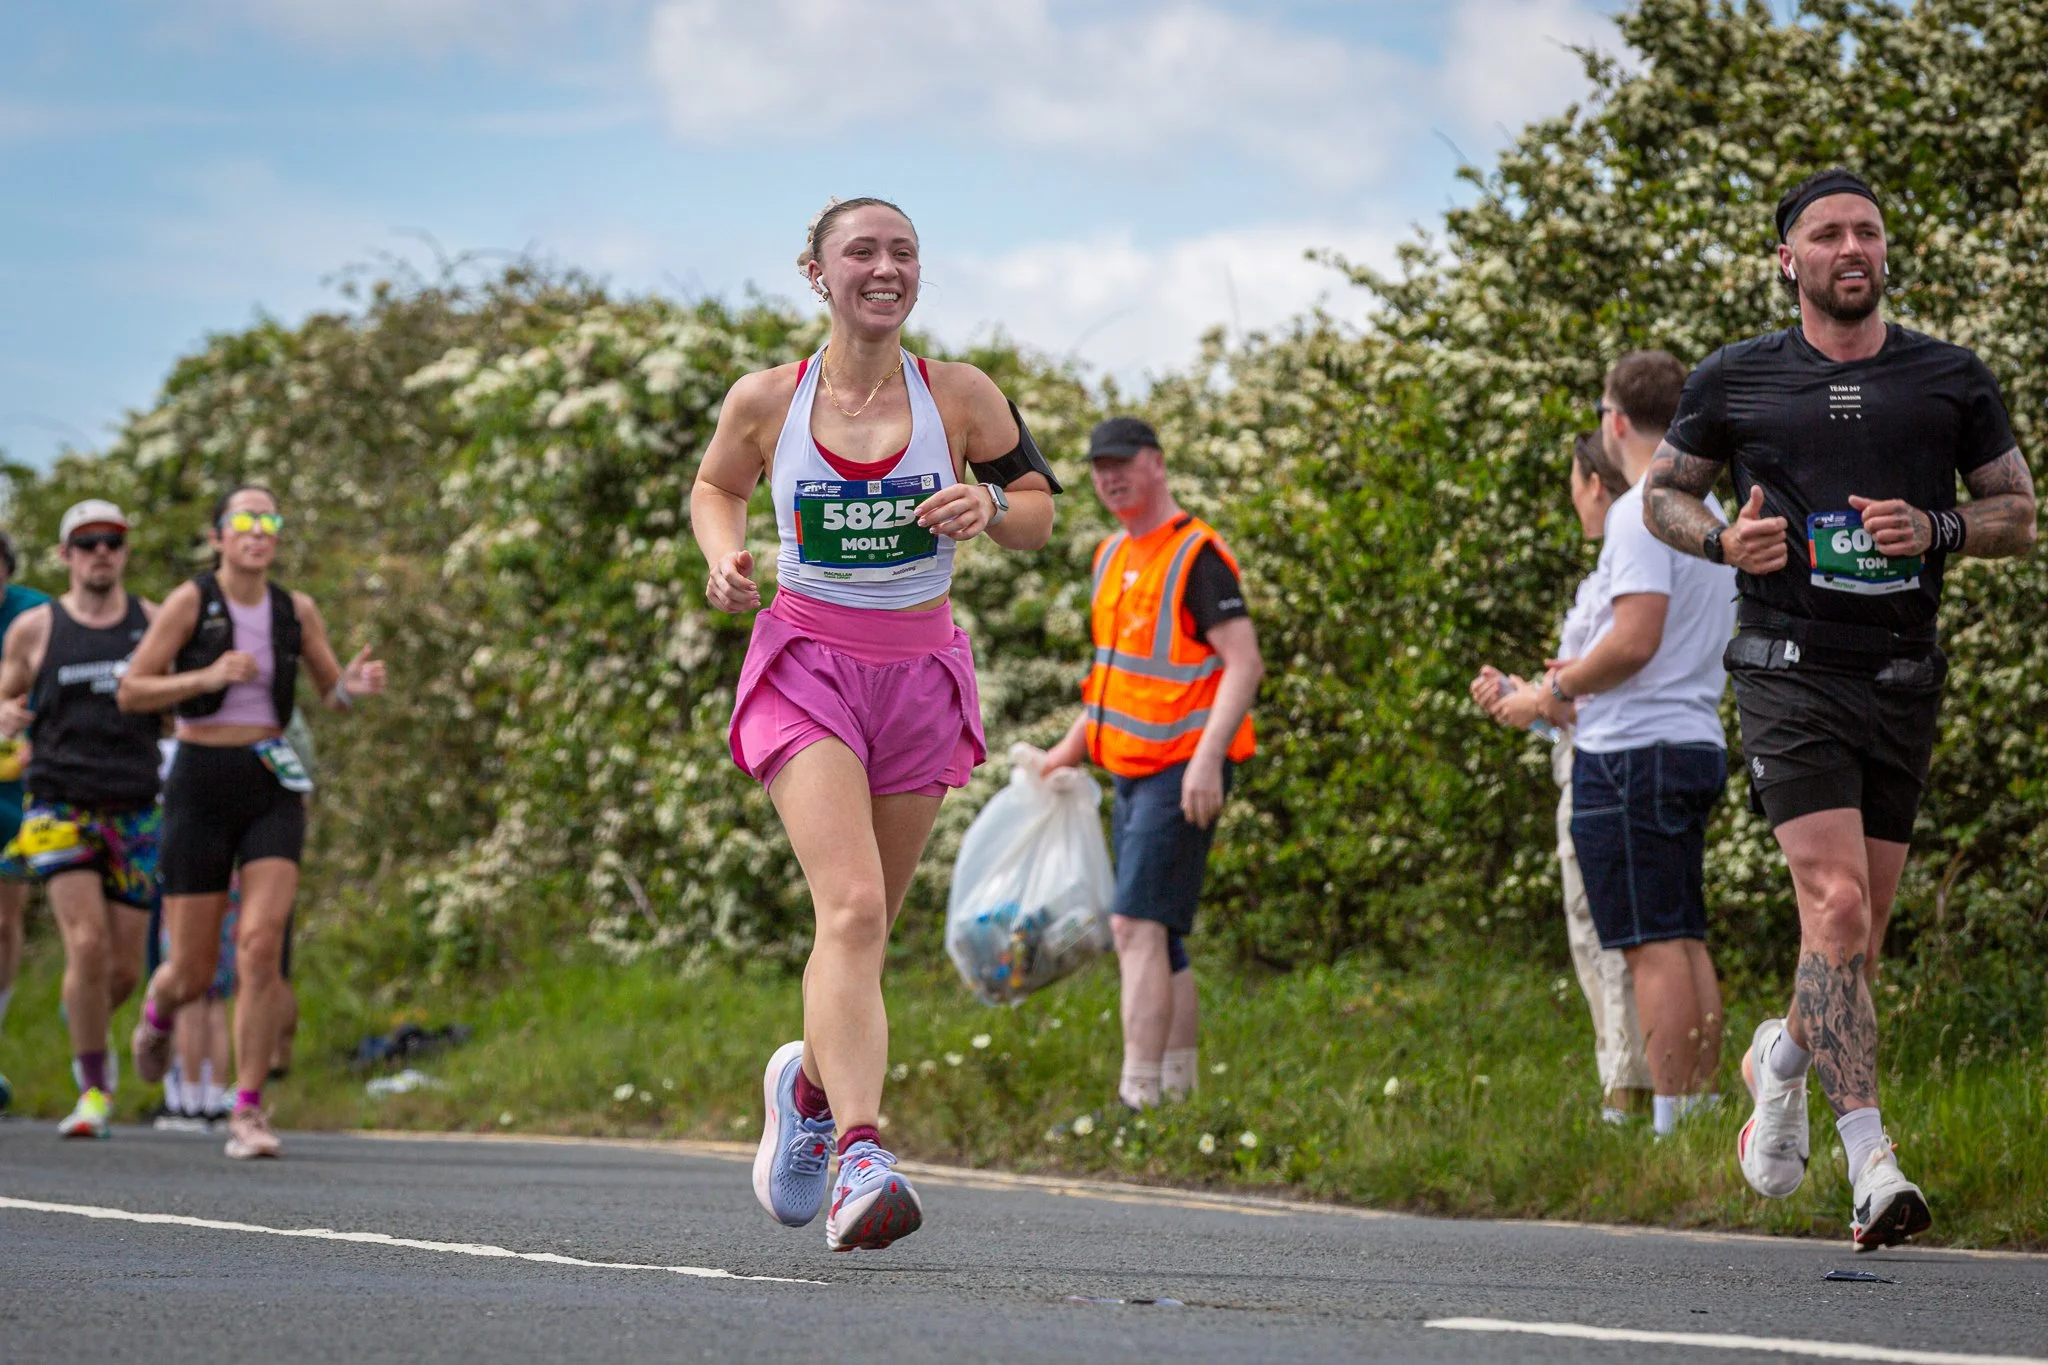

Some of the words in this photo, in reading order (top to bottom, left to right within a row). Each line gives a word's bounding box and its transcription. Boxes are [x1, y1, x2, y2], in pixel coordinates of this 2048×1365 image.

[823, 499, 916, 530] 5825
[841, 534, 900, 551] MOLLY
[1831, 528, 1879, 554] 60
[1856, 557, 1888, 570] TOM
